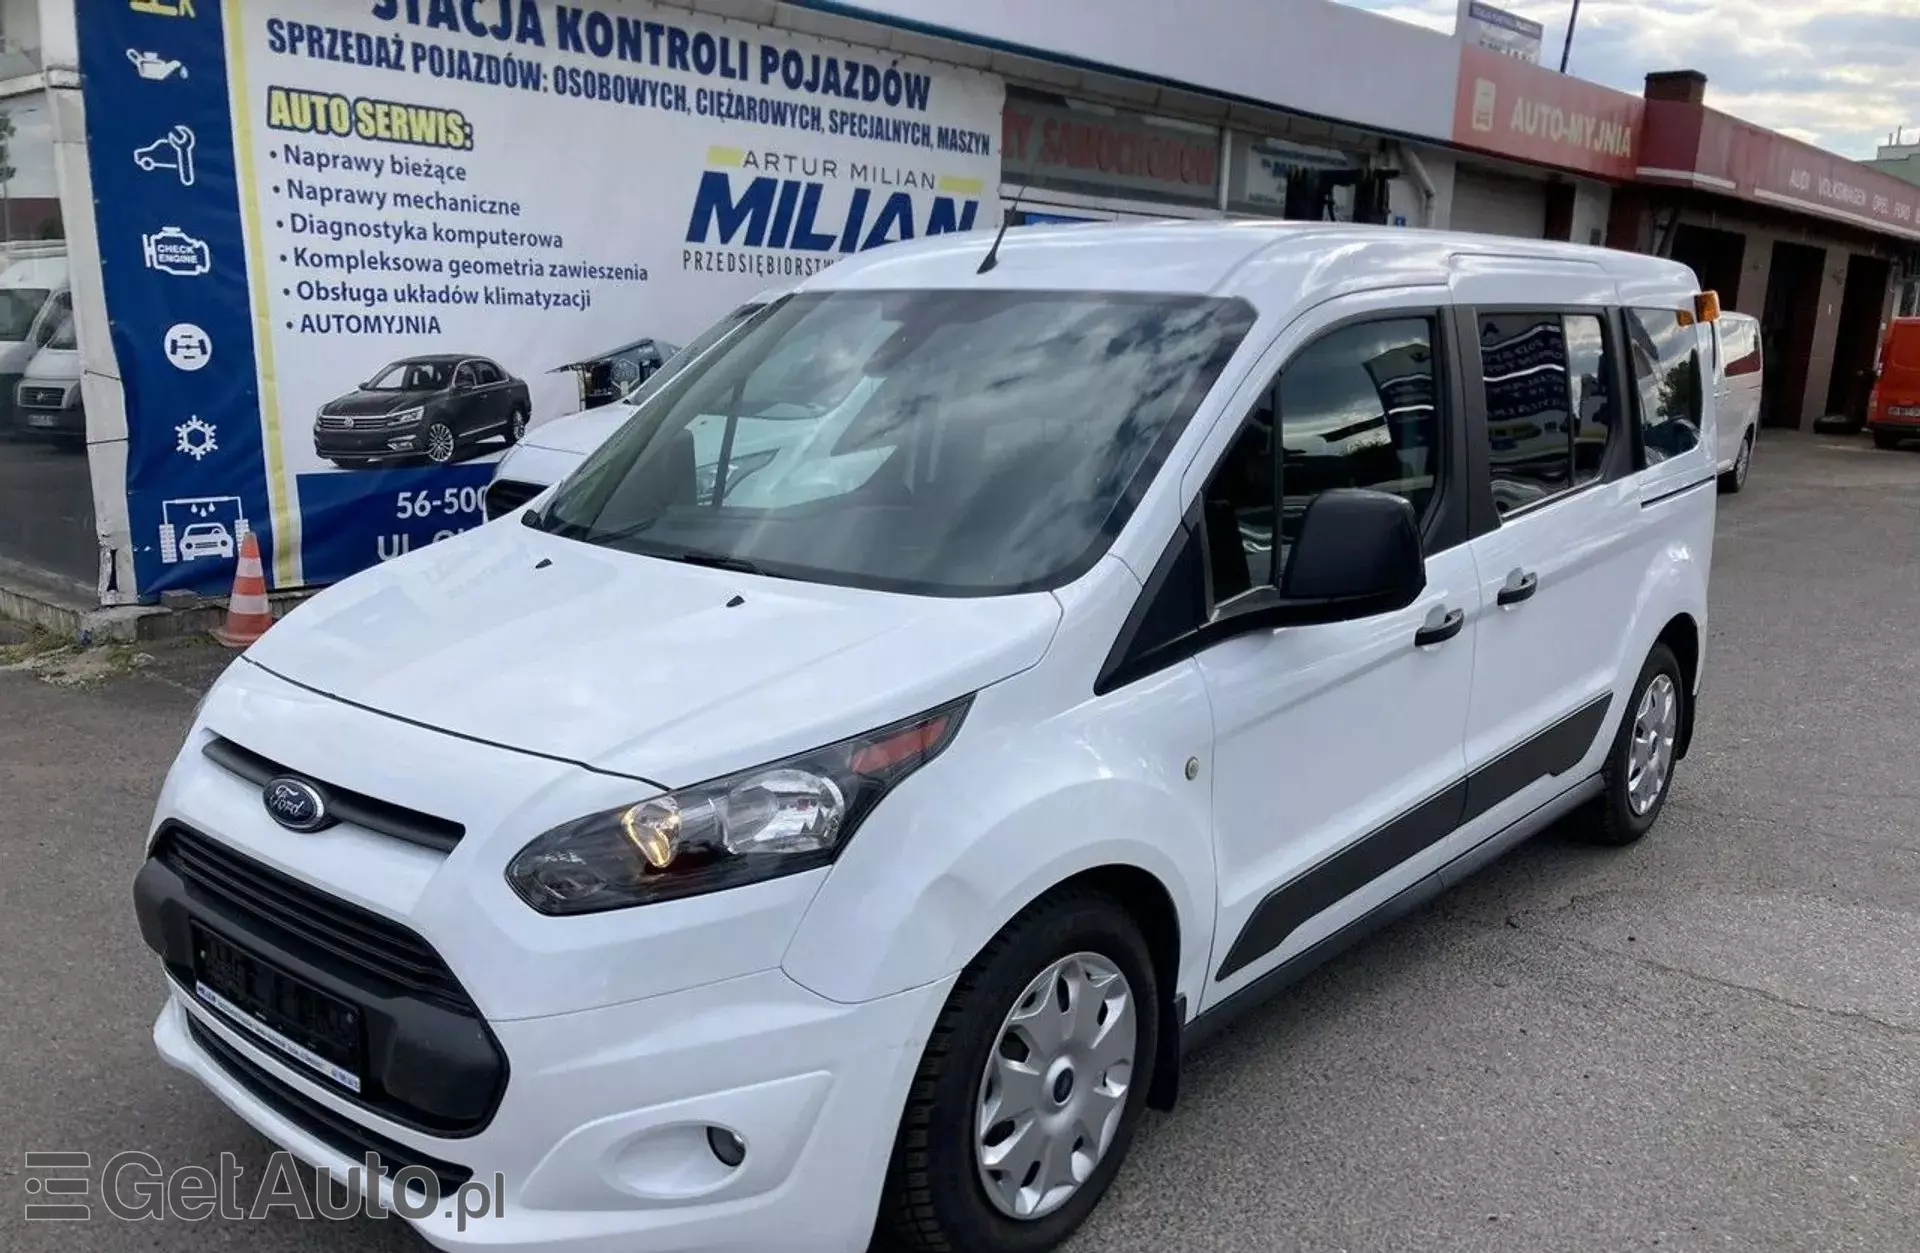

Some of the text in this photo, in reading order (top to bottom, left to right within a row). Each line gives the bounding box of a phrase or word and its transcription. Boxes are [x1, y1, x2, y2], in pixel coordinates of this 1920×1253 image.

[556, 5, 749, 81] KONTROLI
[759, 44, 931, 111] POJAZDÓW
[266, 17, 991, 156] SPRZEDAŻ POJAZDÓW: OSOBOWYCH, CIĘŻAROWYCH, SPECJALNYCH, MASZYN
[267, 85, 474, 151] AUTO SERWIS:
[1510, 97, 1632, 158] AUTO-MYJNIA
[284, 144, 466, 184] Naprawy bieżące
[743, 150, 936, 190] ARTUR MILIAN
[287, 178, 520, 215] Naprawy mechaniczne
[685, 170, 979, 254] MILIAN
[157, 244, 194, 254] CHECK
[290, 213, 563, 249] Diagnostyka komputerowa
[158, 253, 198, 264] ENGINE
[294, 247, 649, 281] Kompleksowa geometria zawieszenia
[296, 280, 591, 311] Obsługa układów klimatyzacji
[300, 313, 442, 335] AUTOMYJNIA
[270, 784, 305, 817] Ford
